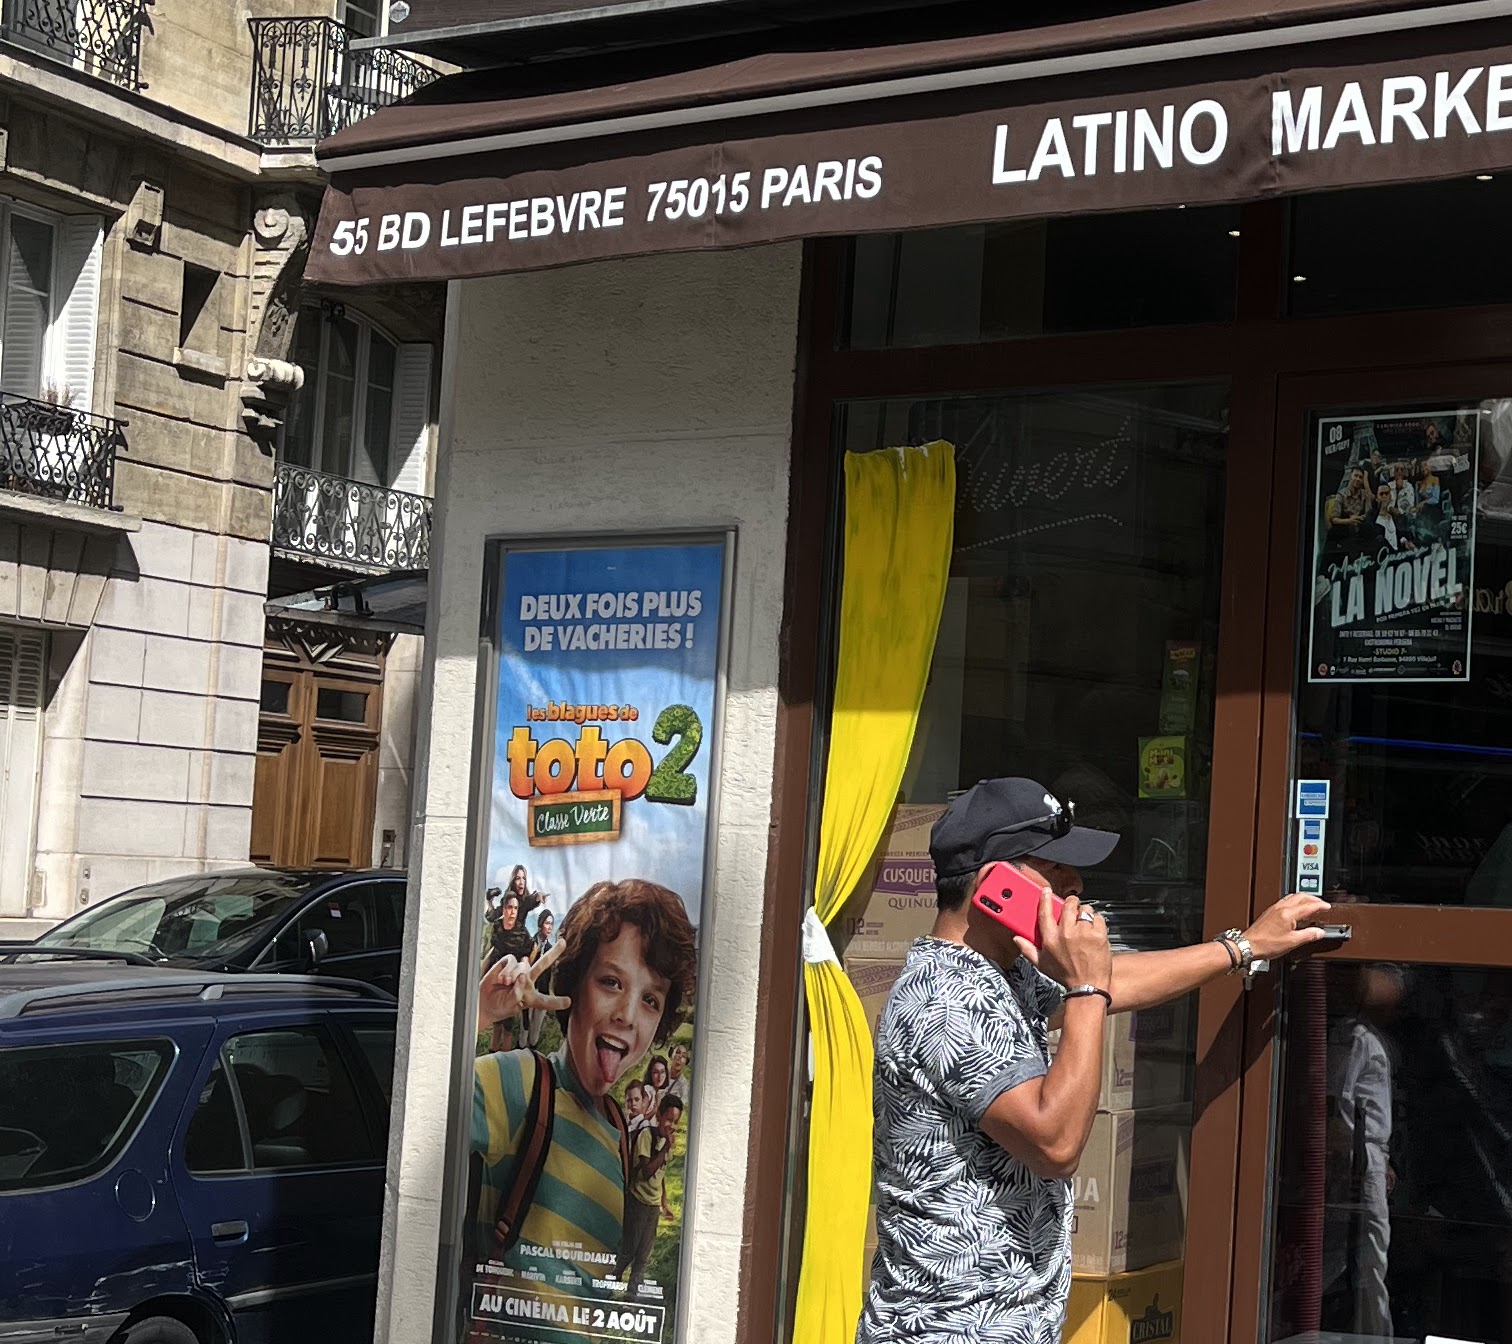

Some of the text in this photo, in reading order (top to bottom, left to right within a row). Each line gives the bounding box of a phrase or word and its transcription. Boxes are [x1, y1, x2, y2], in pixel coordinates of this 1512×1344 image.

[991, 99, 1229, 185] LATINO
[329, 156, 883, 257] 55 BD LEFEBVRE 75015 PARIS
[1331, 573, 1365, 628] LA
[1373, 548, 1463, 616] NOVEL
[519, 590, 703, 621] DEUX FOIS PLUS
[524, 625, 554, 652] DE
[557, 623, 682, 651] VACHERIES
[526, 700, 640, 725] les blagues de
[507, 704, 704, 806] toto 2
[536, 805, 610, 834] Classe Verte
[1302, 862, 1319, 871] VISA
[519, 1244, 617, 1266] PASCAL BOURDIAUX
[479, 1293, 657, 1334] AU CINÉMA LE 2 AOÛT
[1132, 1316, 1172, 1341] CRISTAL
